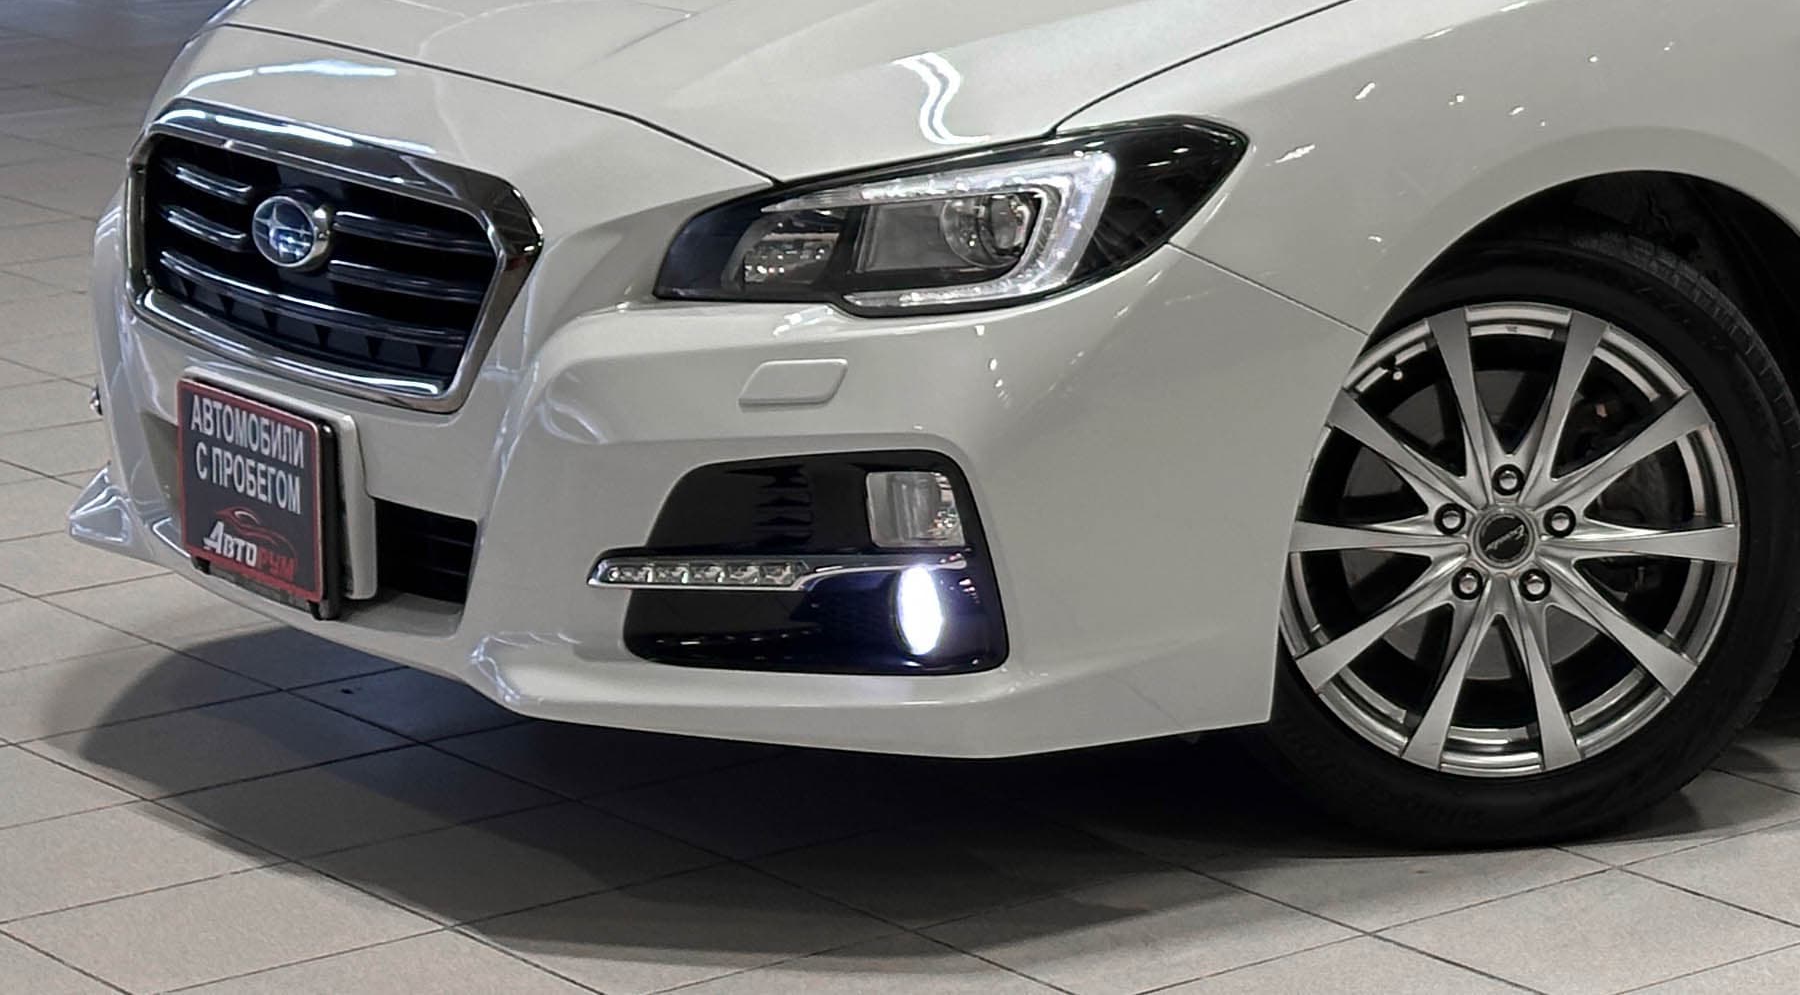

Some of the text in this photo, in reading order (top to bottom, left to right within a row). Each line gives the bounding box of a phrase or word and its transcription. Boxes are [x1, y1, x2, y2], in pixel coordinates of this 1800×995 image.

[191, 394, 304, 468] АВТОМОБИЛИ
[196, 441, 301, 515] С ПРОБЕГОМ
